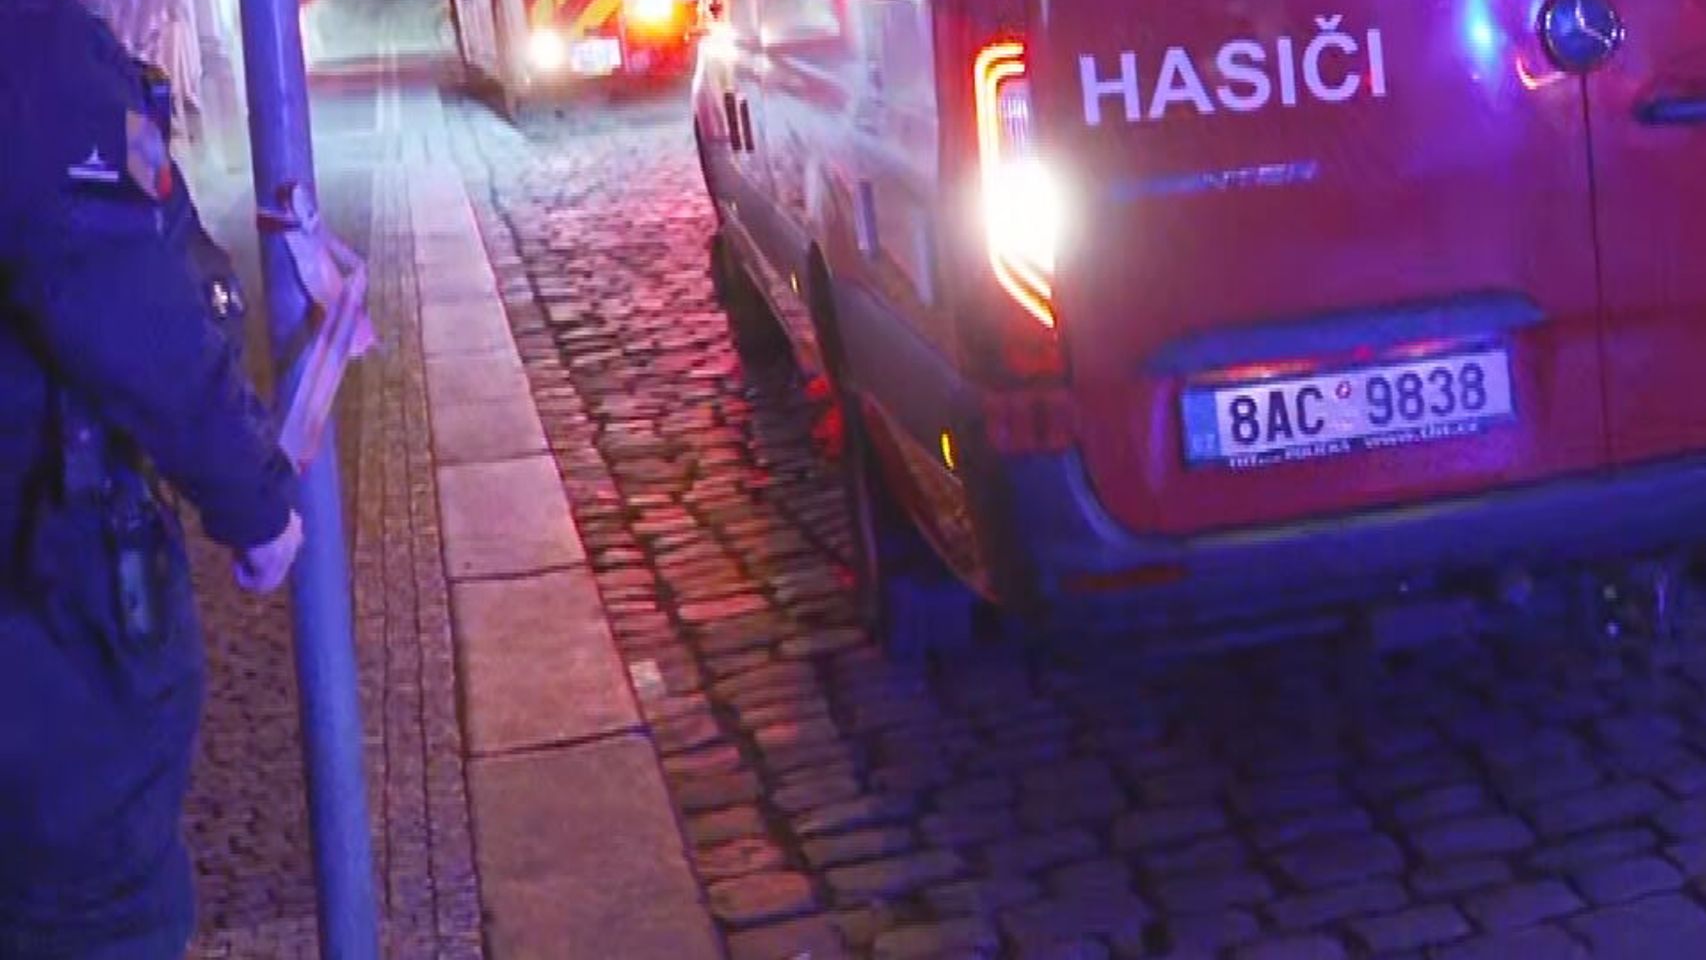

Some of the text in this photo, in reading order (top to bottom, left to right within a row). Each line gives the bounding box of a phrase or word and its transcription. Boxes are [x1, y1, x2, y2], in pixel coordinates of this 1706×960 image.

[1078, 13, 1388, 126] HASIČI
[1229, 362, 1487, 445] 8AC 9838
